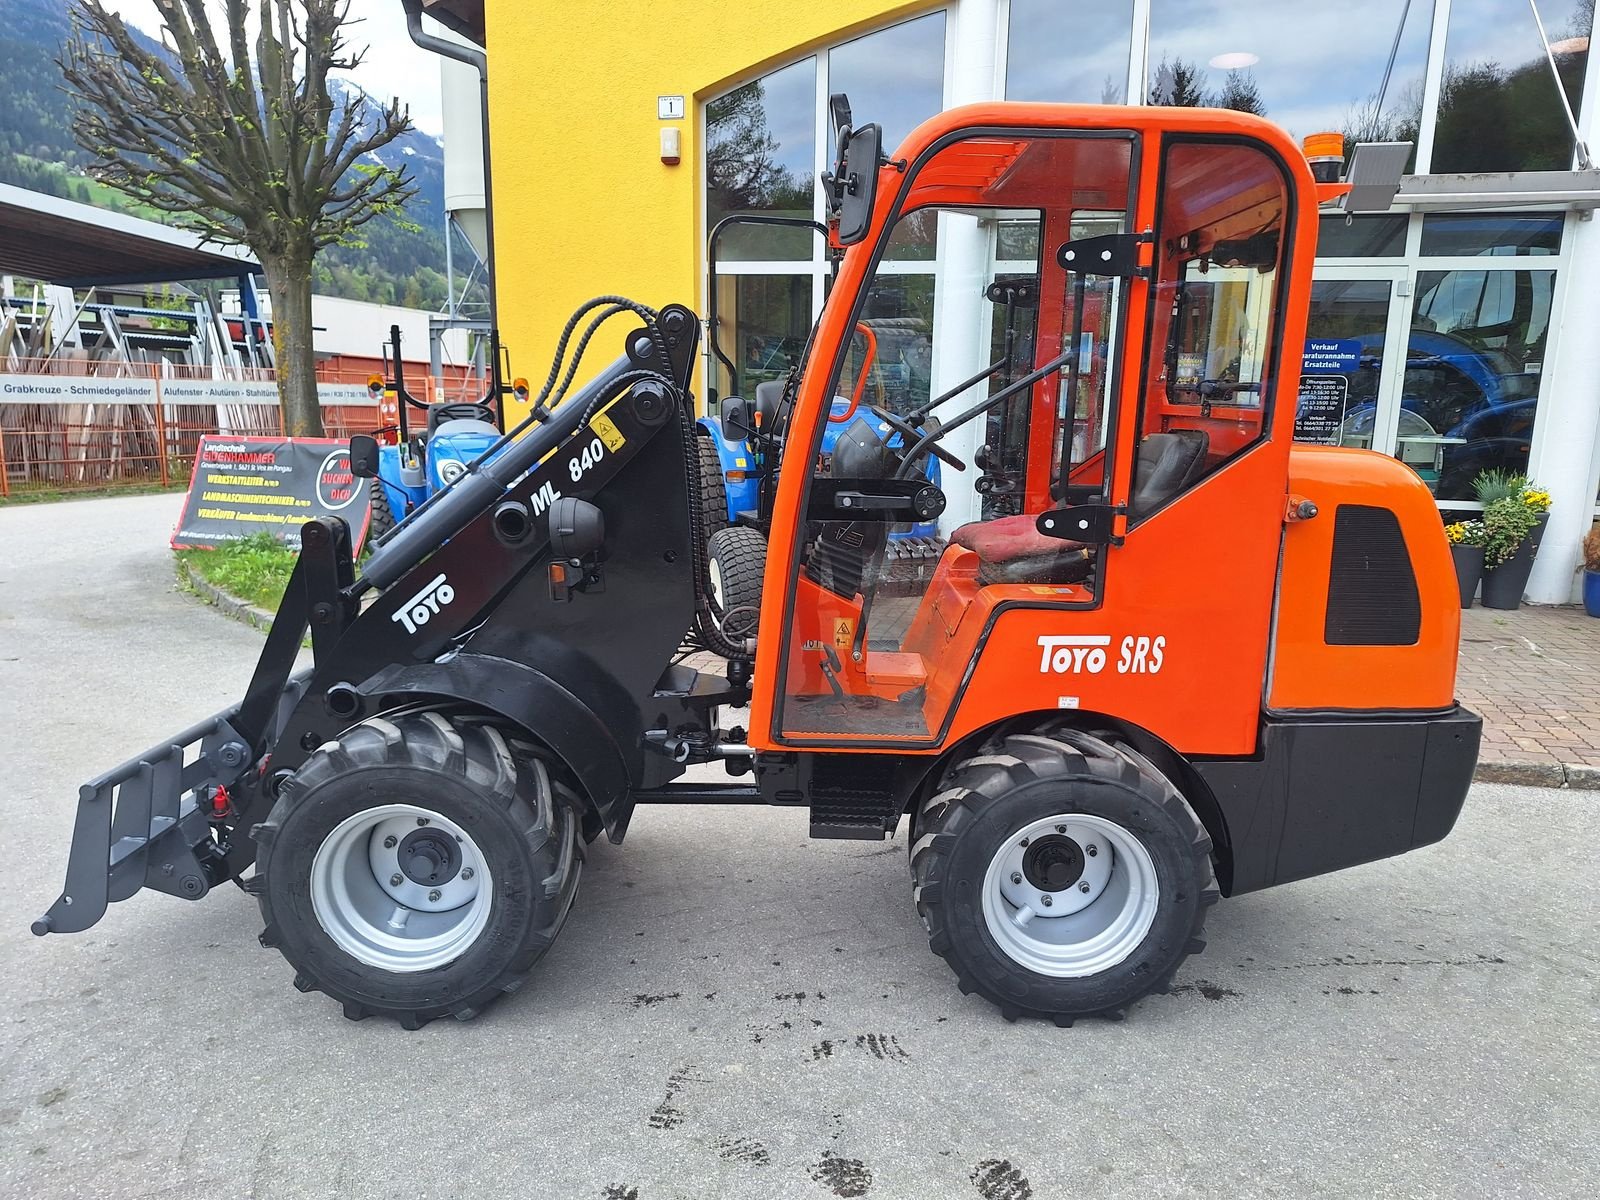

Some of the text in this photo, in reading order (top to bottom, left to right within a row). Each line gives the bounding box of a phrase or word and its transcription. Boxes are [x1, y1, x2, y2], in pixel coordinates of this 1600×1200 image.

[4, 384, 61, 394] Grabkreuze
[70, 385, 151, 397] Schmiedegeländer
[164, 387, 203, 396] Alufenster
[209, 388, 240, 397] Alutüren
[204, 443, 246, 452] Landtechnik
[202, 452, 276, 464] EIDENHAMMER
[207, 474, 264, 486] WERKSTATTLEITER
[322, 473, 353, 484] SUCHEN
[530, 438, 604, 517] ML 840
[202, 491, 295, 506] LANDMASCHINENTECHNIKER
[331, 489, 351, 500] DICH
[391, 573, 455, 635] TOYO
[1037, 635, 1166, 674] TOYO SRS
